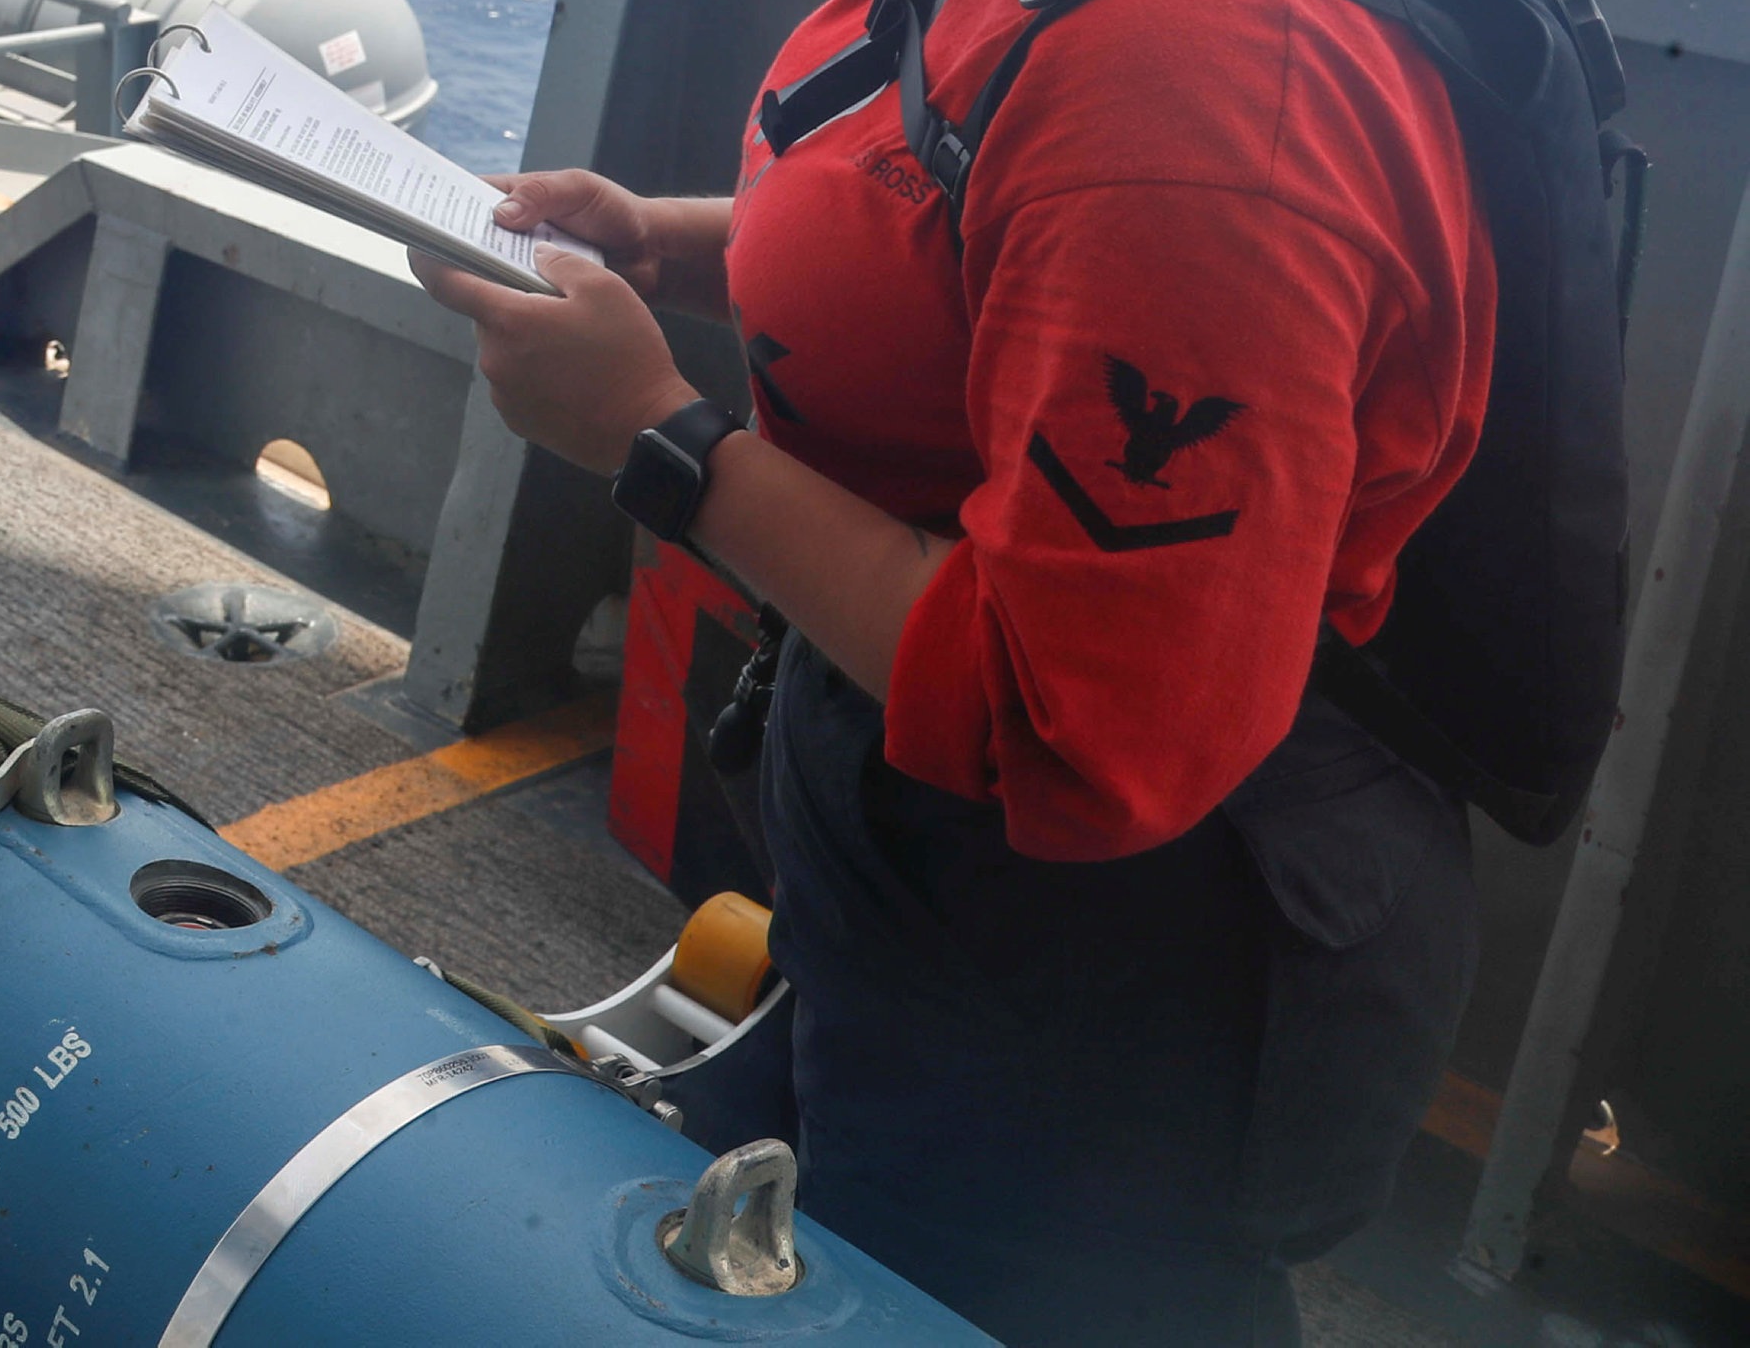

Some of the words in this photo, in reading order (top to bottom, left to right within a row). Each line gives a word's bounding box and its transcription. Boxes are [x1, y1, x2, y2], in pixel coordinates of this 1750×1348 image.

[869, 158, 932, 204] ROSS
[33, 1029, 92, 1090] LBS
[69, 1247, 110, 1306] 2.1
